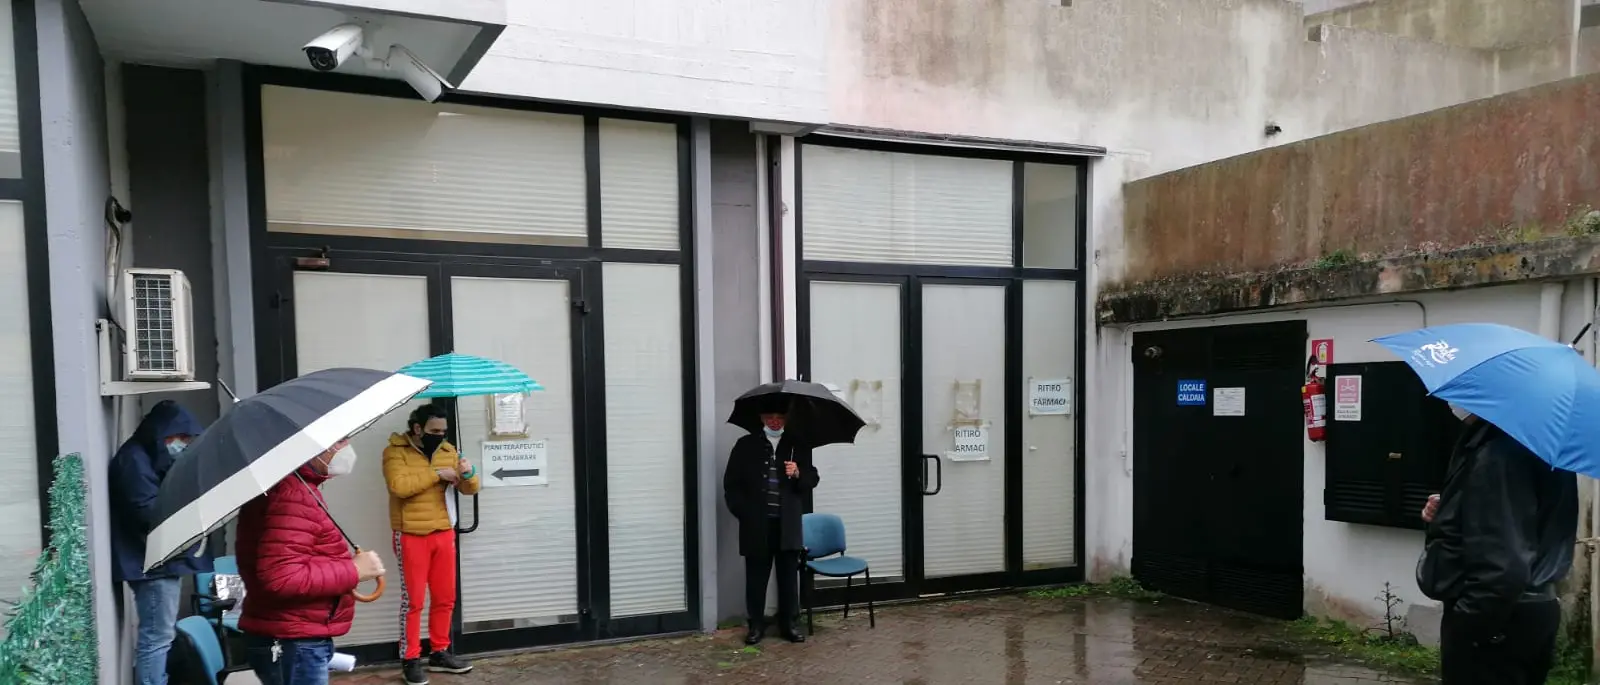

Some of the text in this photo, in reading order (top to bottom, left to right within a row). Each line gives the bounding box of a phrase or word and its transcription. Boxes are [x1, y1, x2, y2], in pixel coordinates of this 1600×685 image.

[1037, 384, 1061, 392] RITIRO
[1179, 383, 1205, 391] LOCALE
[1033, 397, 1066, 406] FARMACI
[1177, 393, 1205, 402] CALDAIA
[955, 429, 981, 438] RITIRO
